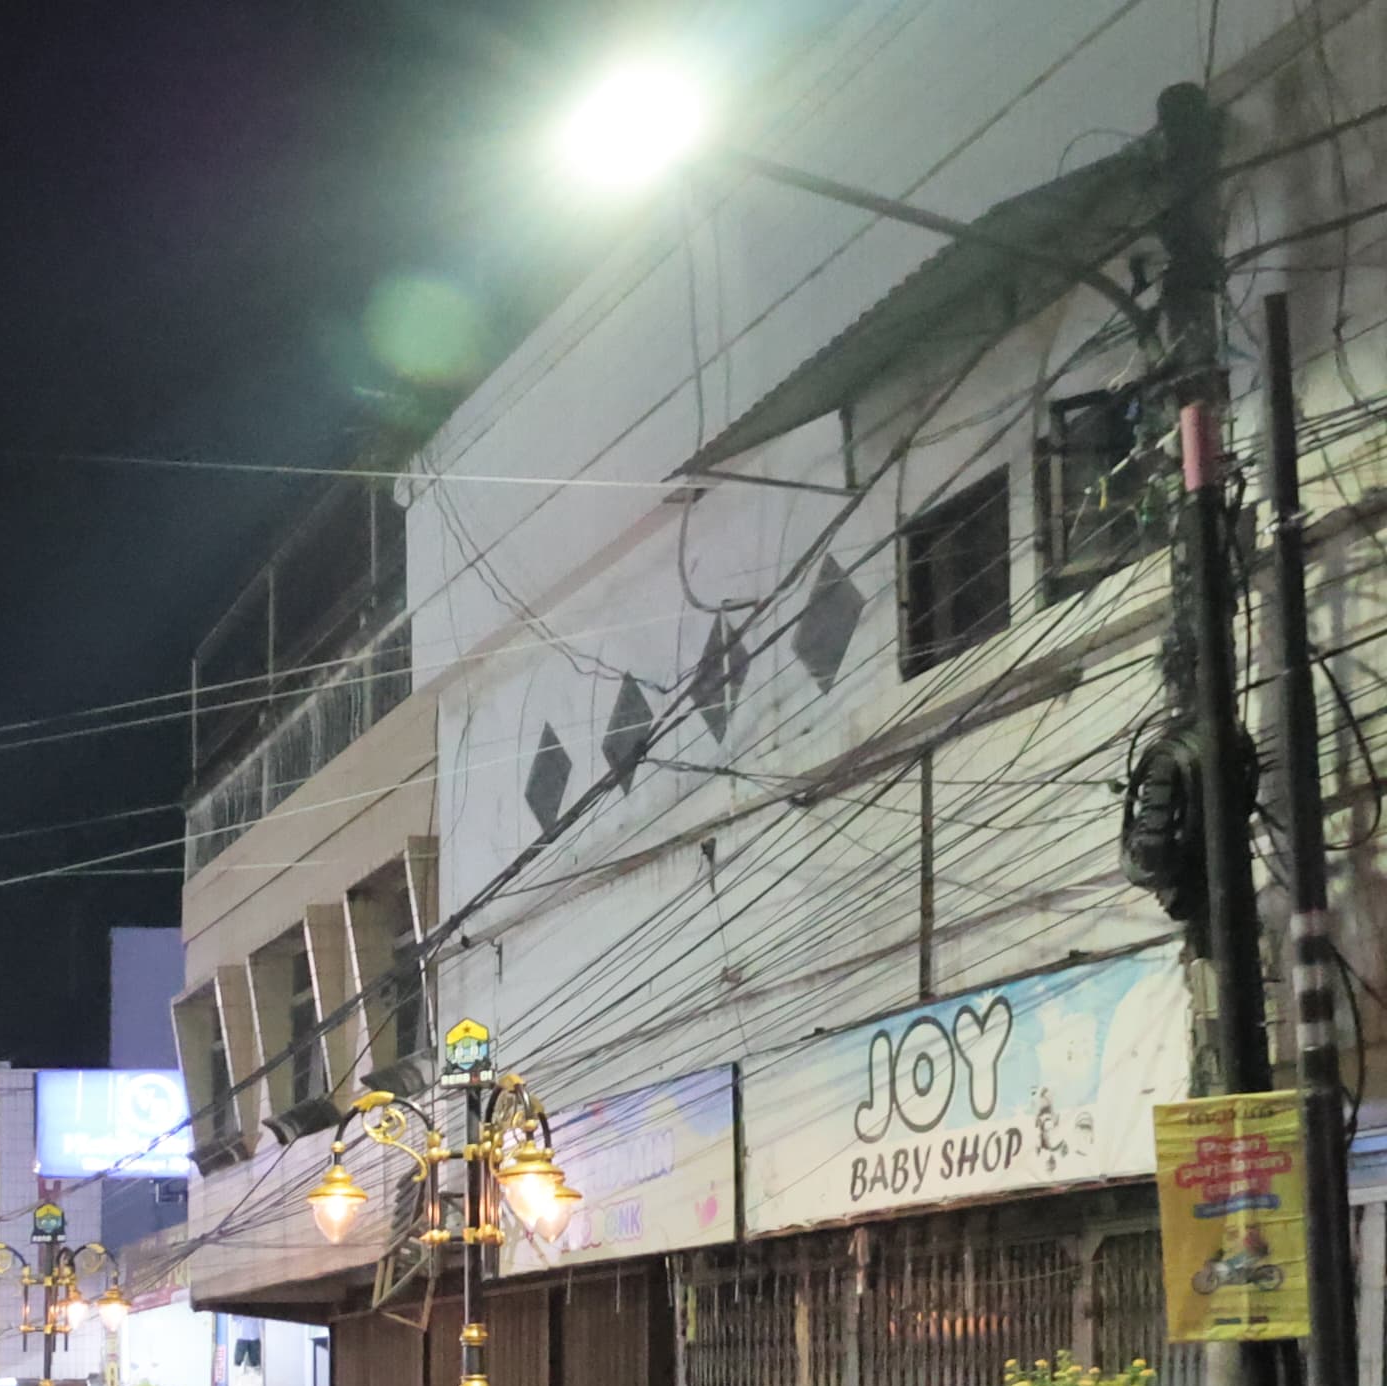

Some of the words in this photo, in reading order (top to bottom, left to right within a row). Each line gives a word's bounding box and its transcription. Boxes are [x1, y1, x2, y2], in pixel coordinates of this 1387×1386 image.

[854, 996, 1013, 1144] JOY
[850, 1144, 932, 1202] BABY
[940, 1127, 1023, 1181] SHOP
